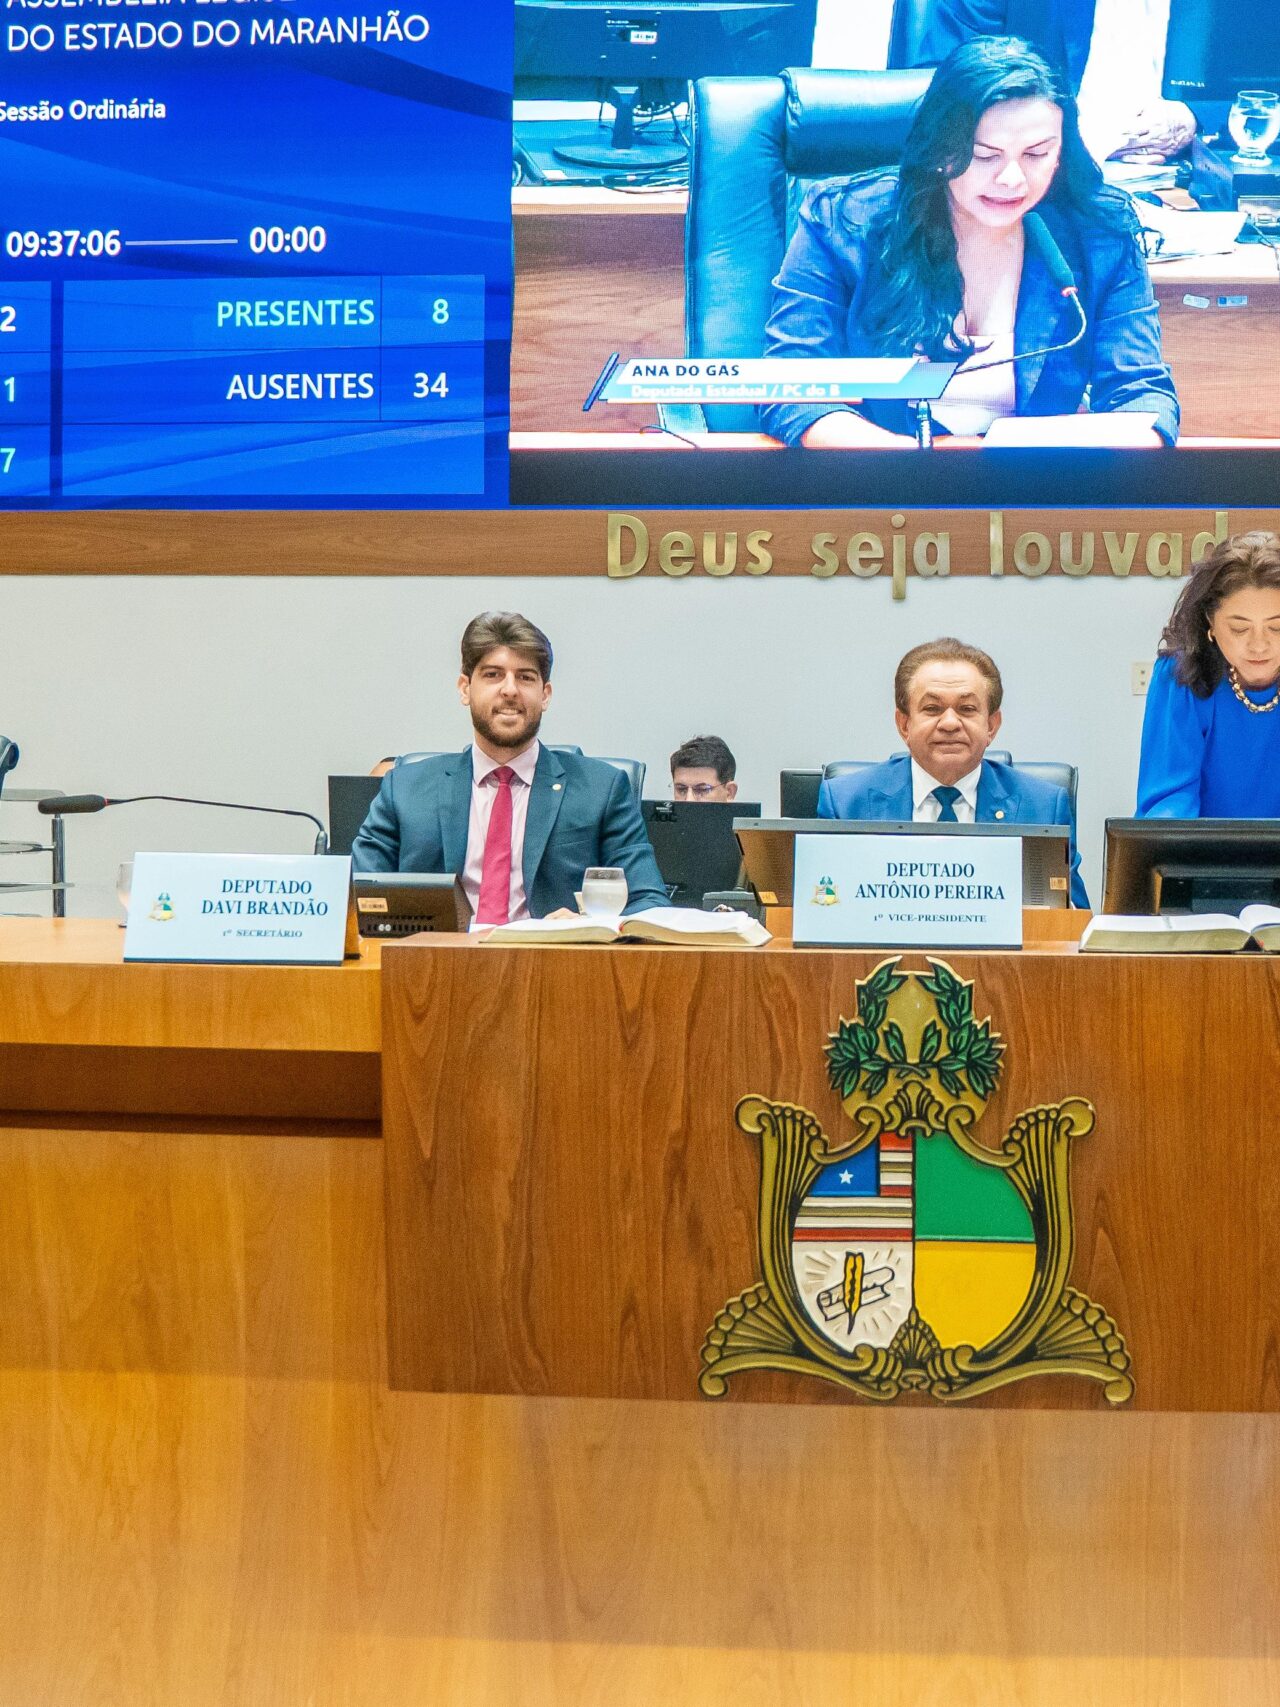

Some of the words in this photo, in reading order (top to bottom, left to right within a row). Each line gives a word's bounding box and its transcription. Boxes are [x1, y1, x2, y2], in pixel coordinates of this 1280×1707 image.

[7, 24, 55, 52] DO
[64, 20, 183, 50] ESTADO
[192, 19, 241, 47] DO
[250, 9, 430, 45] MARANHÃO
[68, 97, 167, 120] Ordinária
[5, 229, 121, 258] 09:37:06
[249, 225, 326, 253] 00:00
[0, 305, 16, 332] 2
[217, 299, 375, 328] PRESENTES
[432, 298, 450, 325] 8
[632, 365, 670, 377] ANA
[675, 365, 700, 377] DO
[3, 376, 15, 402] 1
[225, 372, 374, 400] AUSENTES
[413, 372, 449, 398] 34
[706, 385, 767, 397] Estadual
[782, 385, 801, 397] PC
[805, 385, 826, 397] do
[0, 447, 16, 474] 7
[607, 513, 773, 578] Deus
[810, 513, 950, 601] seja
[886, 862, 976, 878] DEPUTADO
[221, 879, 313, 895] DEPUTADO
[855, 880, 931, 900] ANTÔNIO
[934, 884, 1006, 900] PEREIRA
[201, 899, 242, 915] DAVI
[246, 898, 329, 916] BRANDÃO
[888, 913, 987, 924] VICE-PRESIDENTE
[236, 928, 304, 938] SECRETÁRIO
